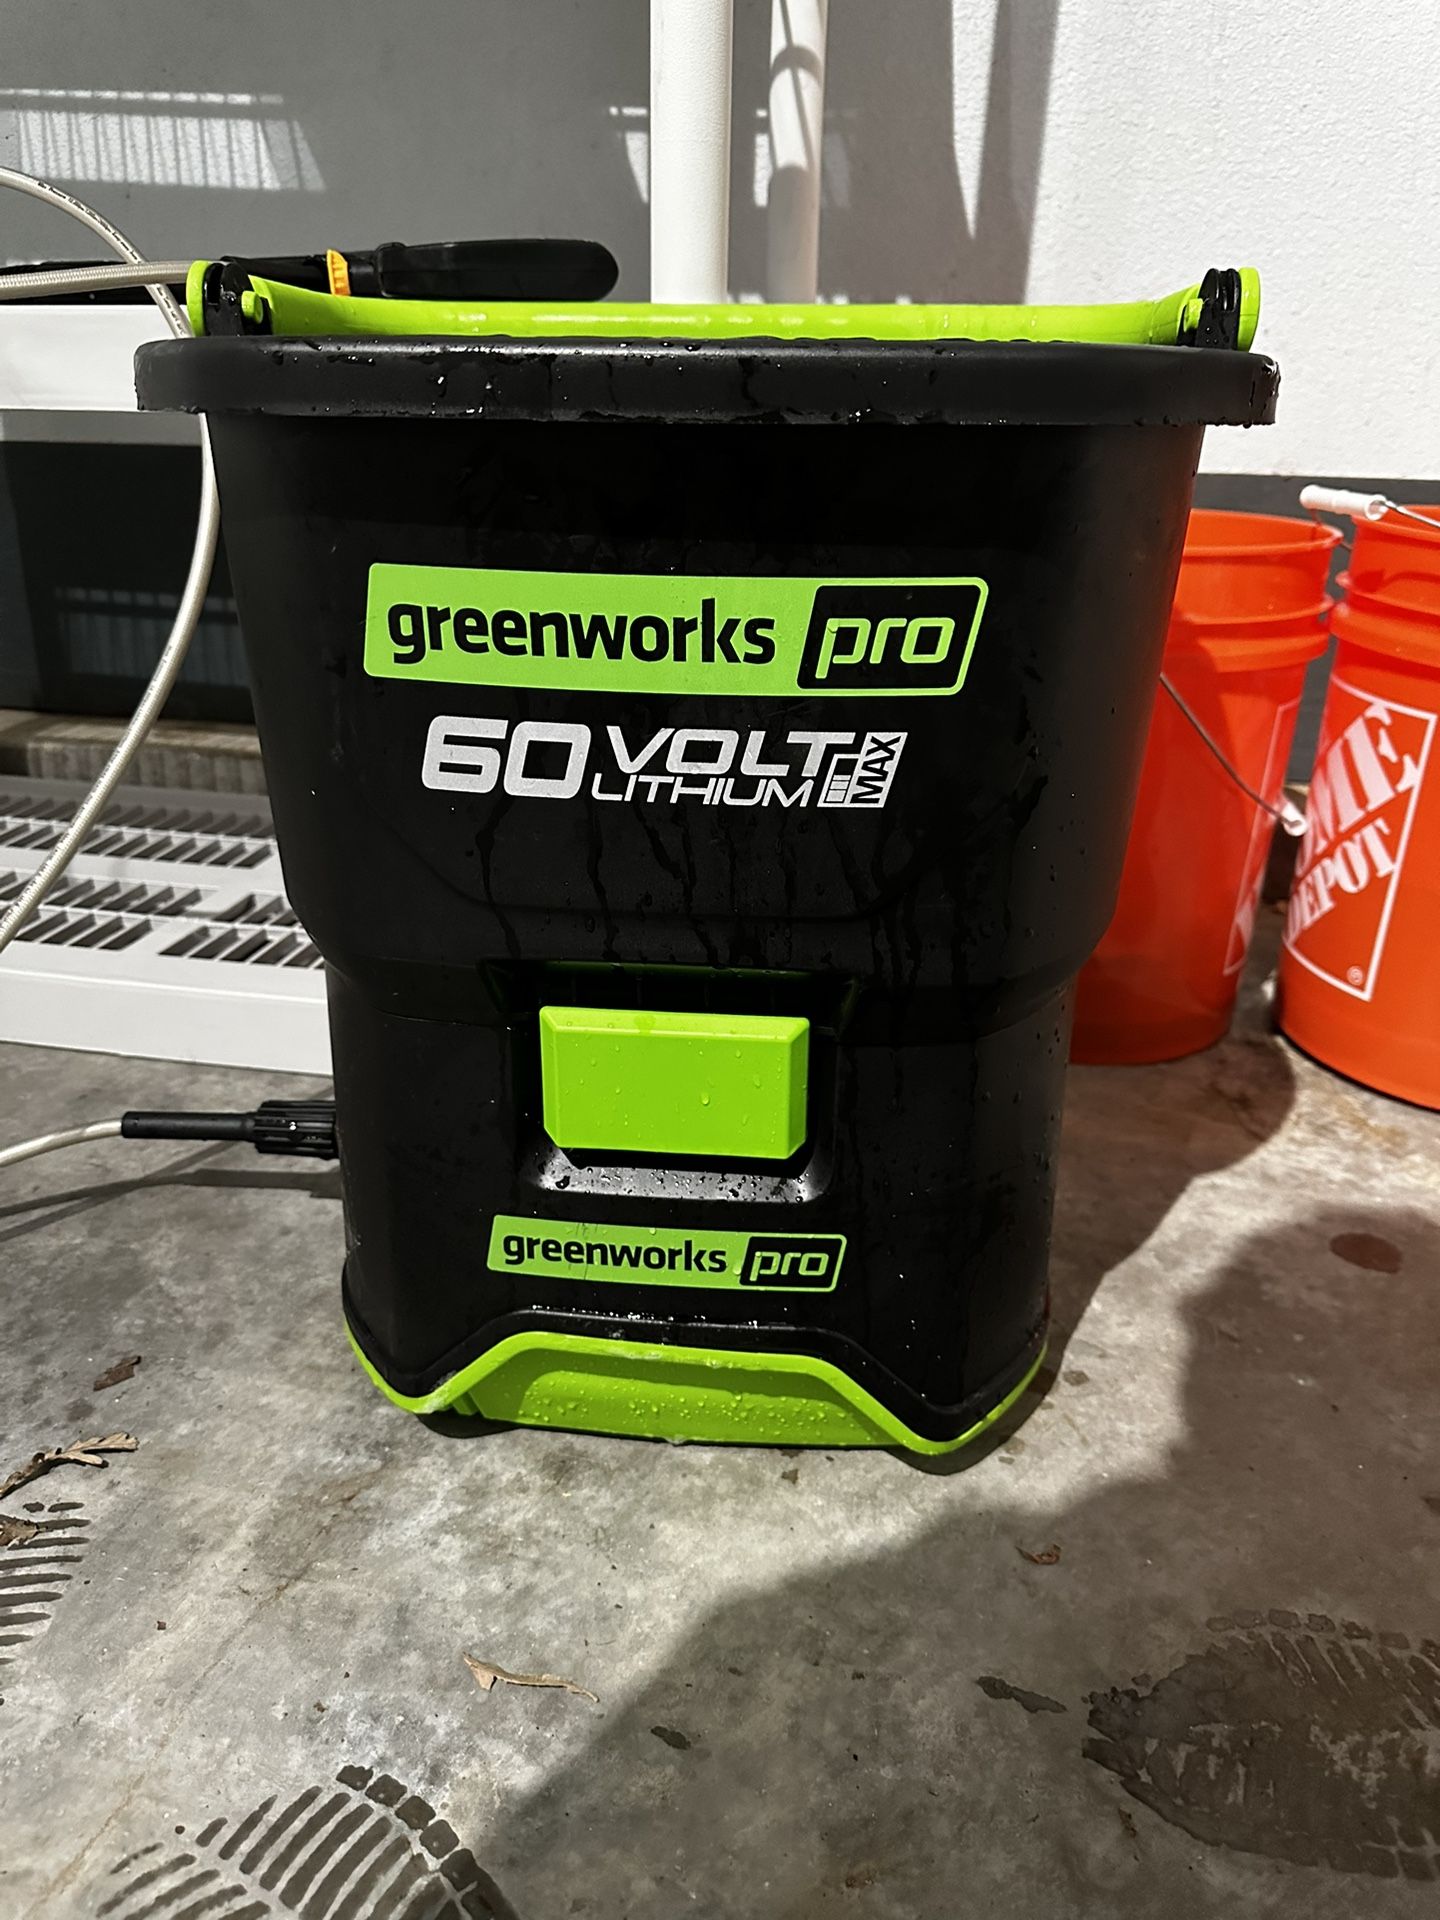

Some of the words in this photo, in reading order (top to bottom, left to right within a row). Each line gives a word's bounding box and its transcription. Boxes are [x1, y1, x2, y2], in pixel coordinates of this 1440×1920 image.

[388, 597, 776, 665] greenworks
[814, 617, 956, 680] pro
[421, 715, 592, 799] 60
[606, 725, 856, 777] VOLT
[591, 772, 815, 808] LITHIUM
[849, 735, 902, 804] MAX
[502, 1234, 728, 1274] greenworks
[748, 1250, 830, 1282] pro
